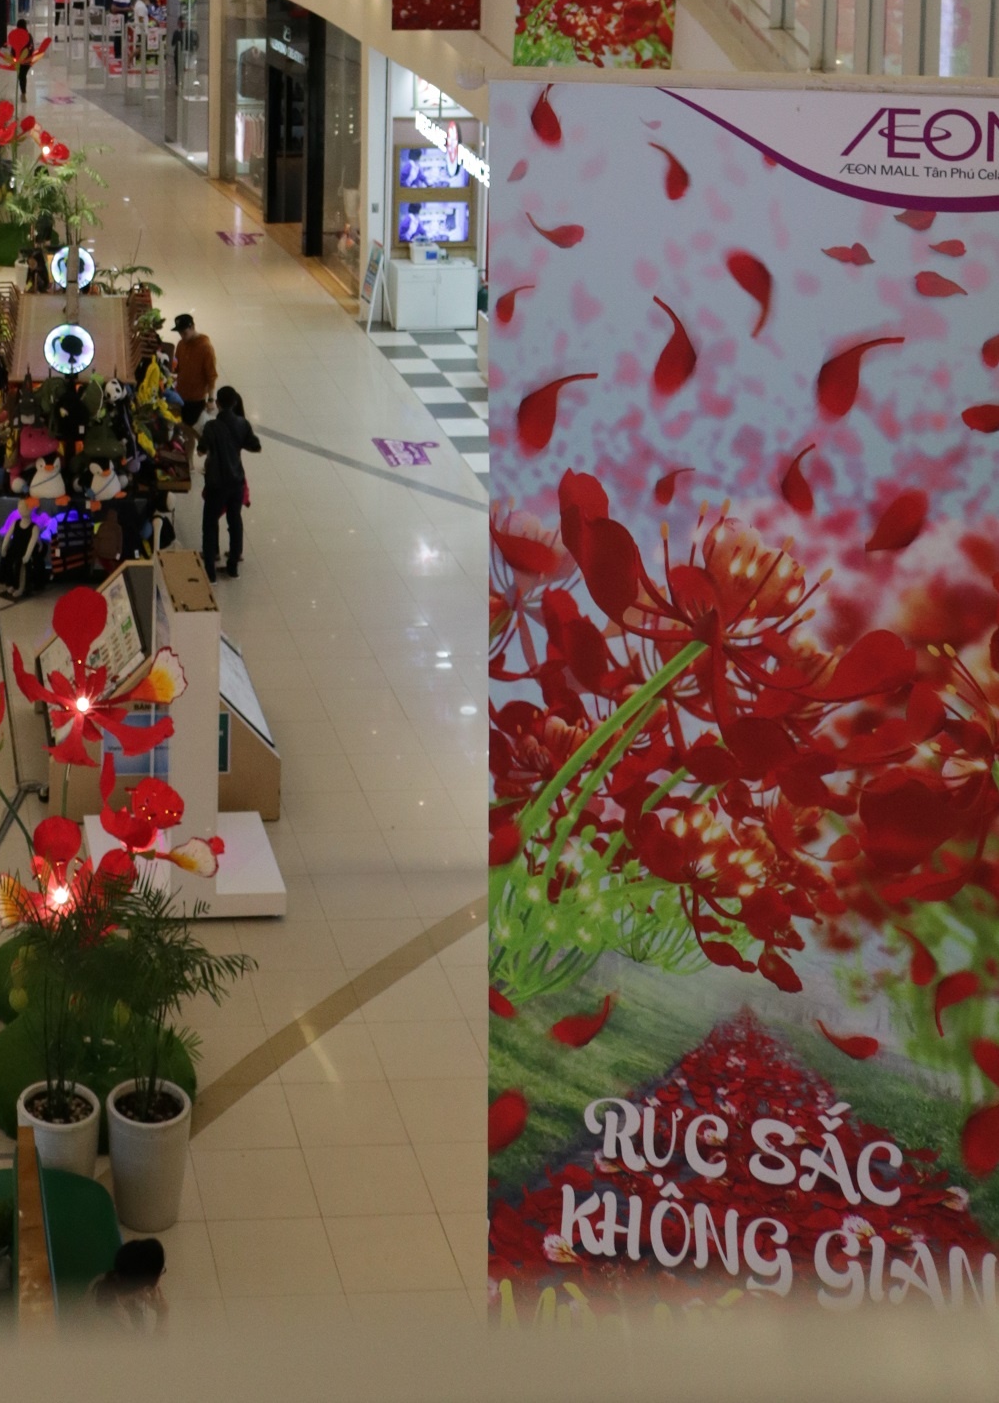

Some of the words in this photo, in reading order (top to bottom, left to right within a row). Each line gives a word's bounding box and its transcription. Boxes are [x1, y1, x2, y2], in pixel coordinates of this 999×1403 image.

[880, 165, 920, 177] MALL
[923, 166, 947, 178] Tân
[950, 168, 975, 180] Phú
[978, 168, 999, 181] Cel
[749, 1102, 903, 1207] SẮC
[560, 1181, 794, 1297] KHÔNG
